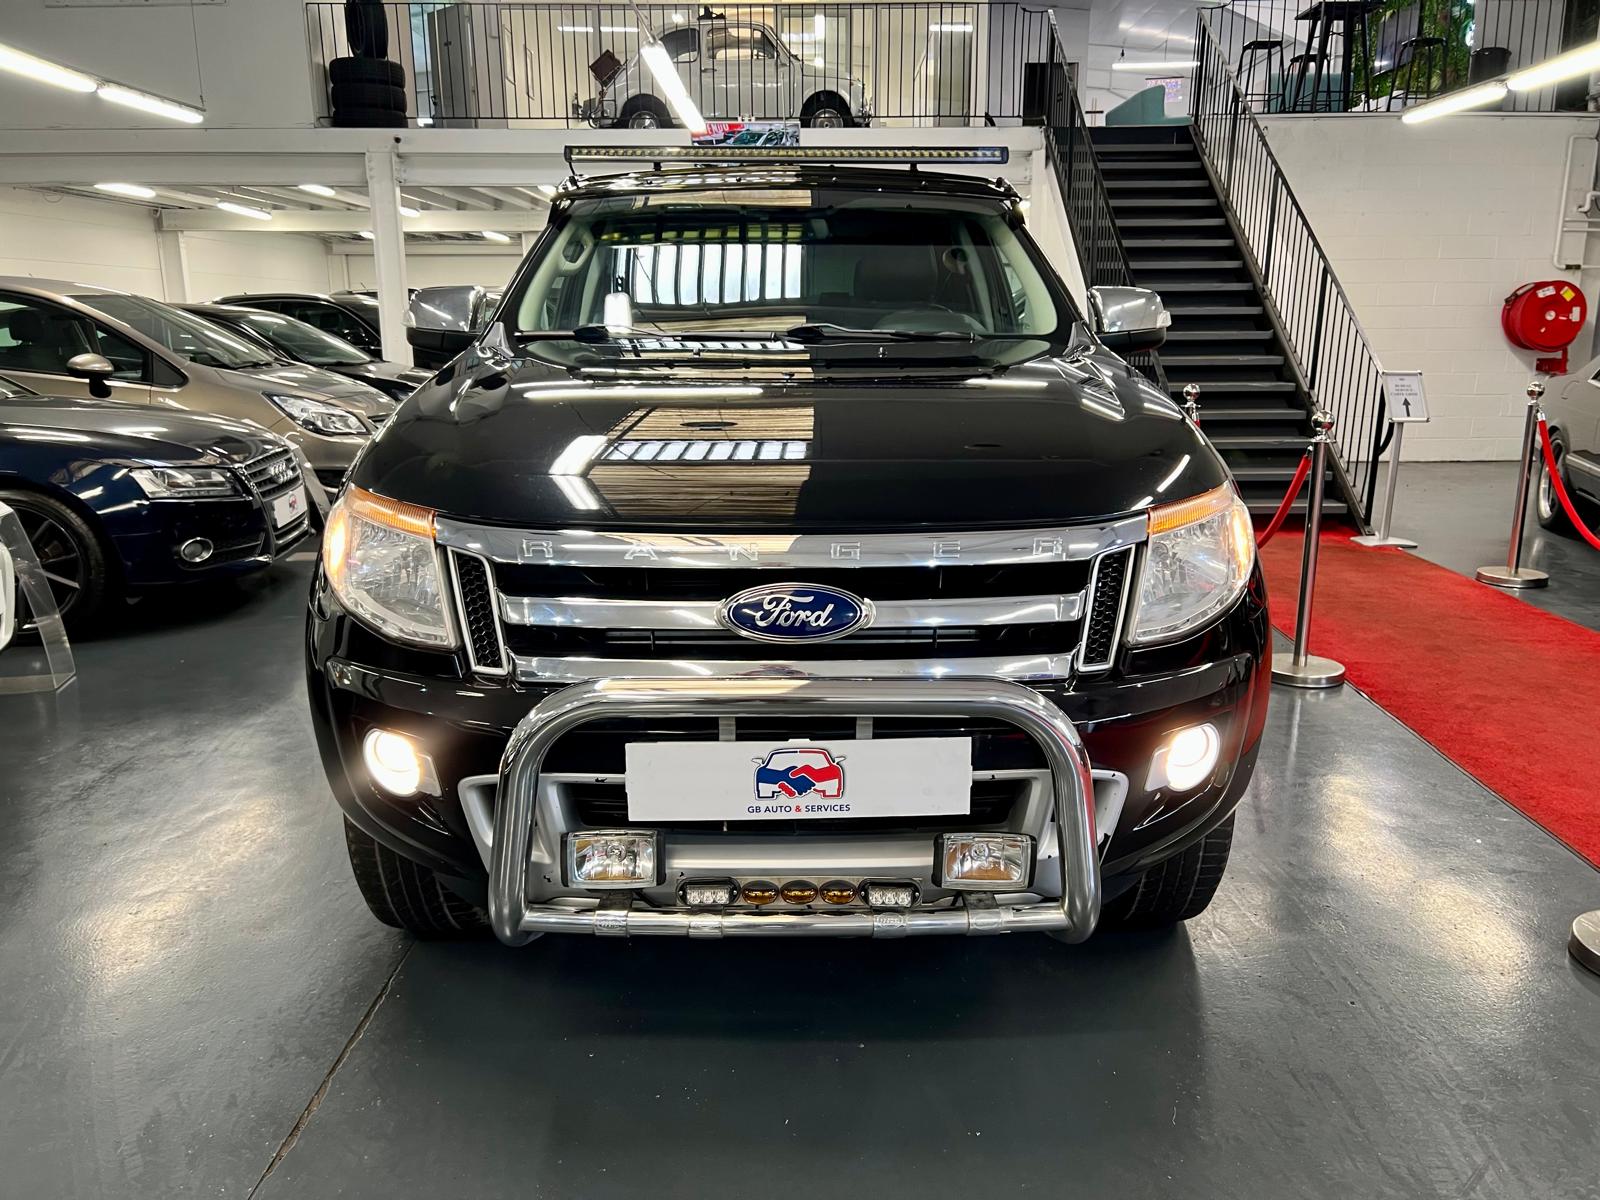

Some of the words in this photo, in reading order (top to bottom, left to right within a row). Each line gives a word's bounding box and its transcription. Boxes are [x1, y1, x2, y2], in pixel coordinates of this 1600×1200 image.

[522, 536, 1068, 562] RANGER
[740, 594, 835, 627] Ford
[747, 805, 761, 813] GB
[764, 805, 792, 813] AUTO
[794, 804, 802, 812] &
[804, 803, 851, 812] SERVICES
